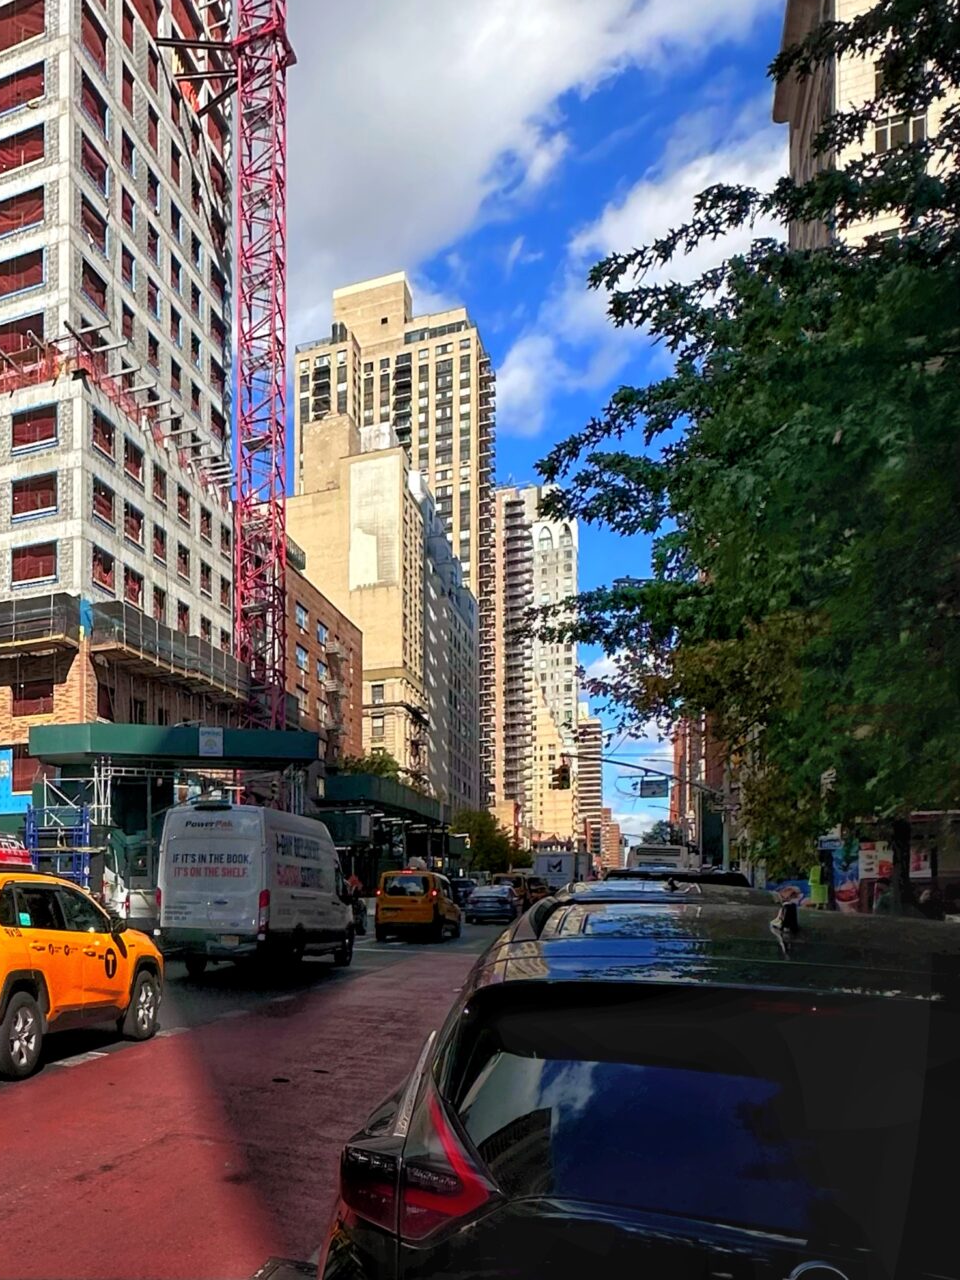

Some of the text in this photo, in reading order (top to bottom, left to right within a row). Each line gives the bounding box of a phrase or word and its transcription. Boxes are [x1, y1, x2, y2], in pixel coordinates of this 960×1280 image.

[172, 853, 181, 864] IF
[181, 853, 197, 864] IT'S
[198, 853, 207, 864] IN
[209, 853, 225, 864] THE
[174, 867, 189, 878] IT'S
[190, 867, 202, 878] ON
[204, 867, 220, 878] THE
